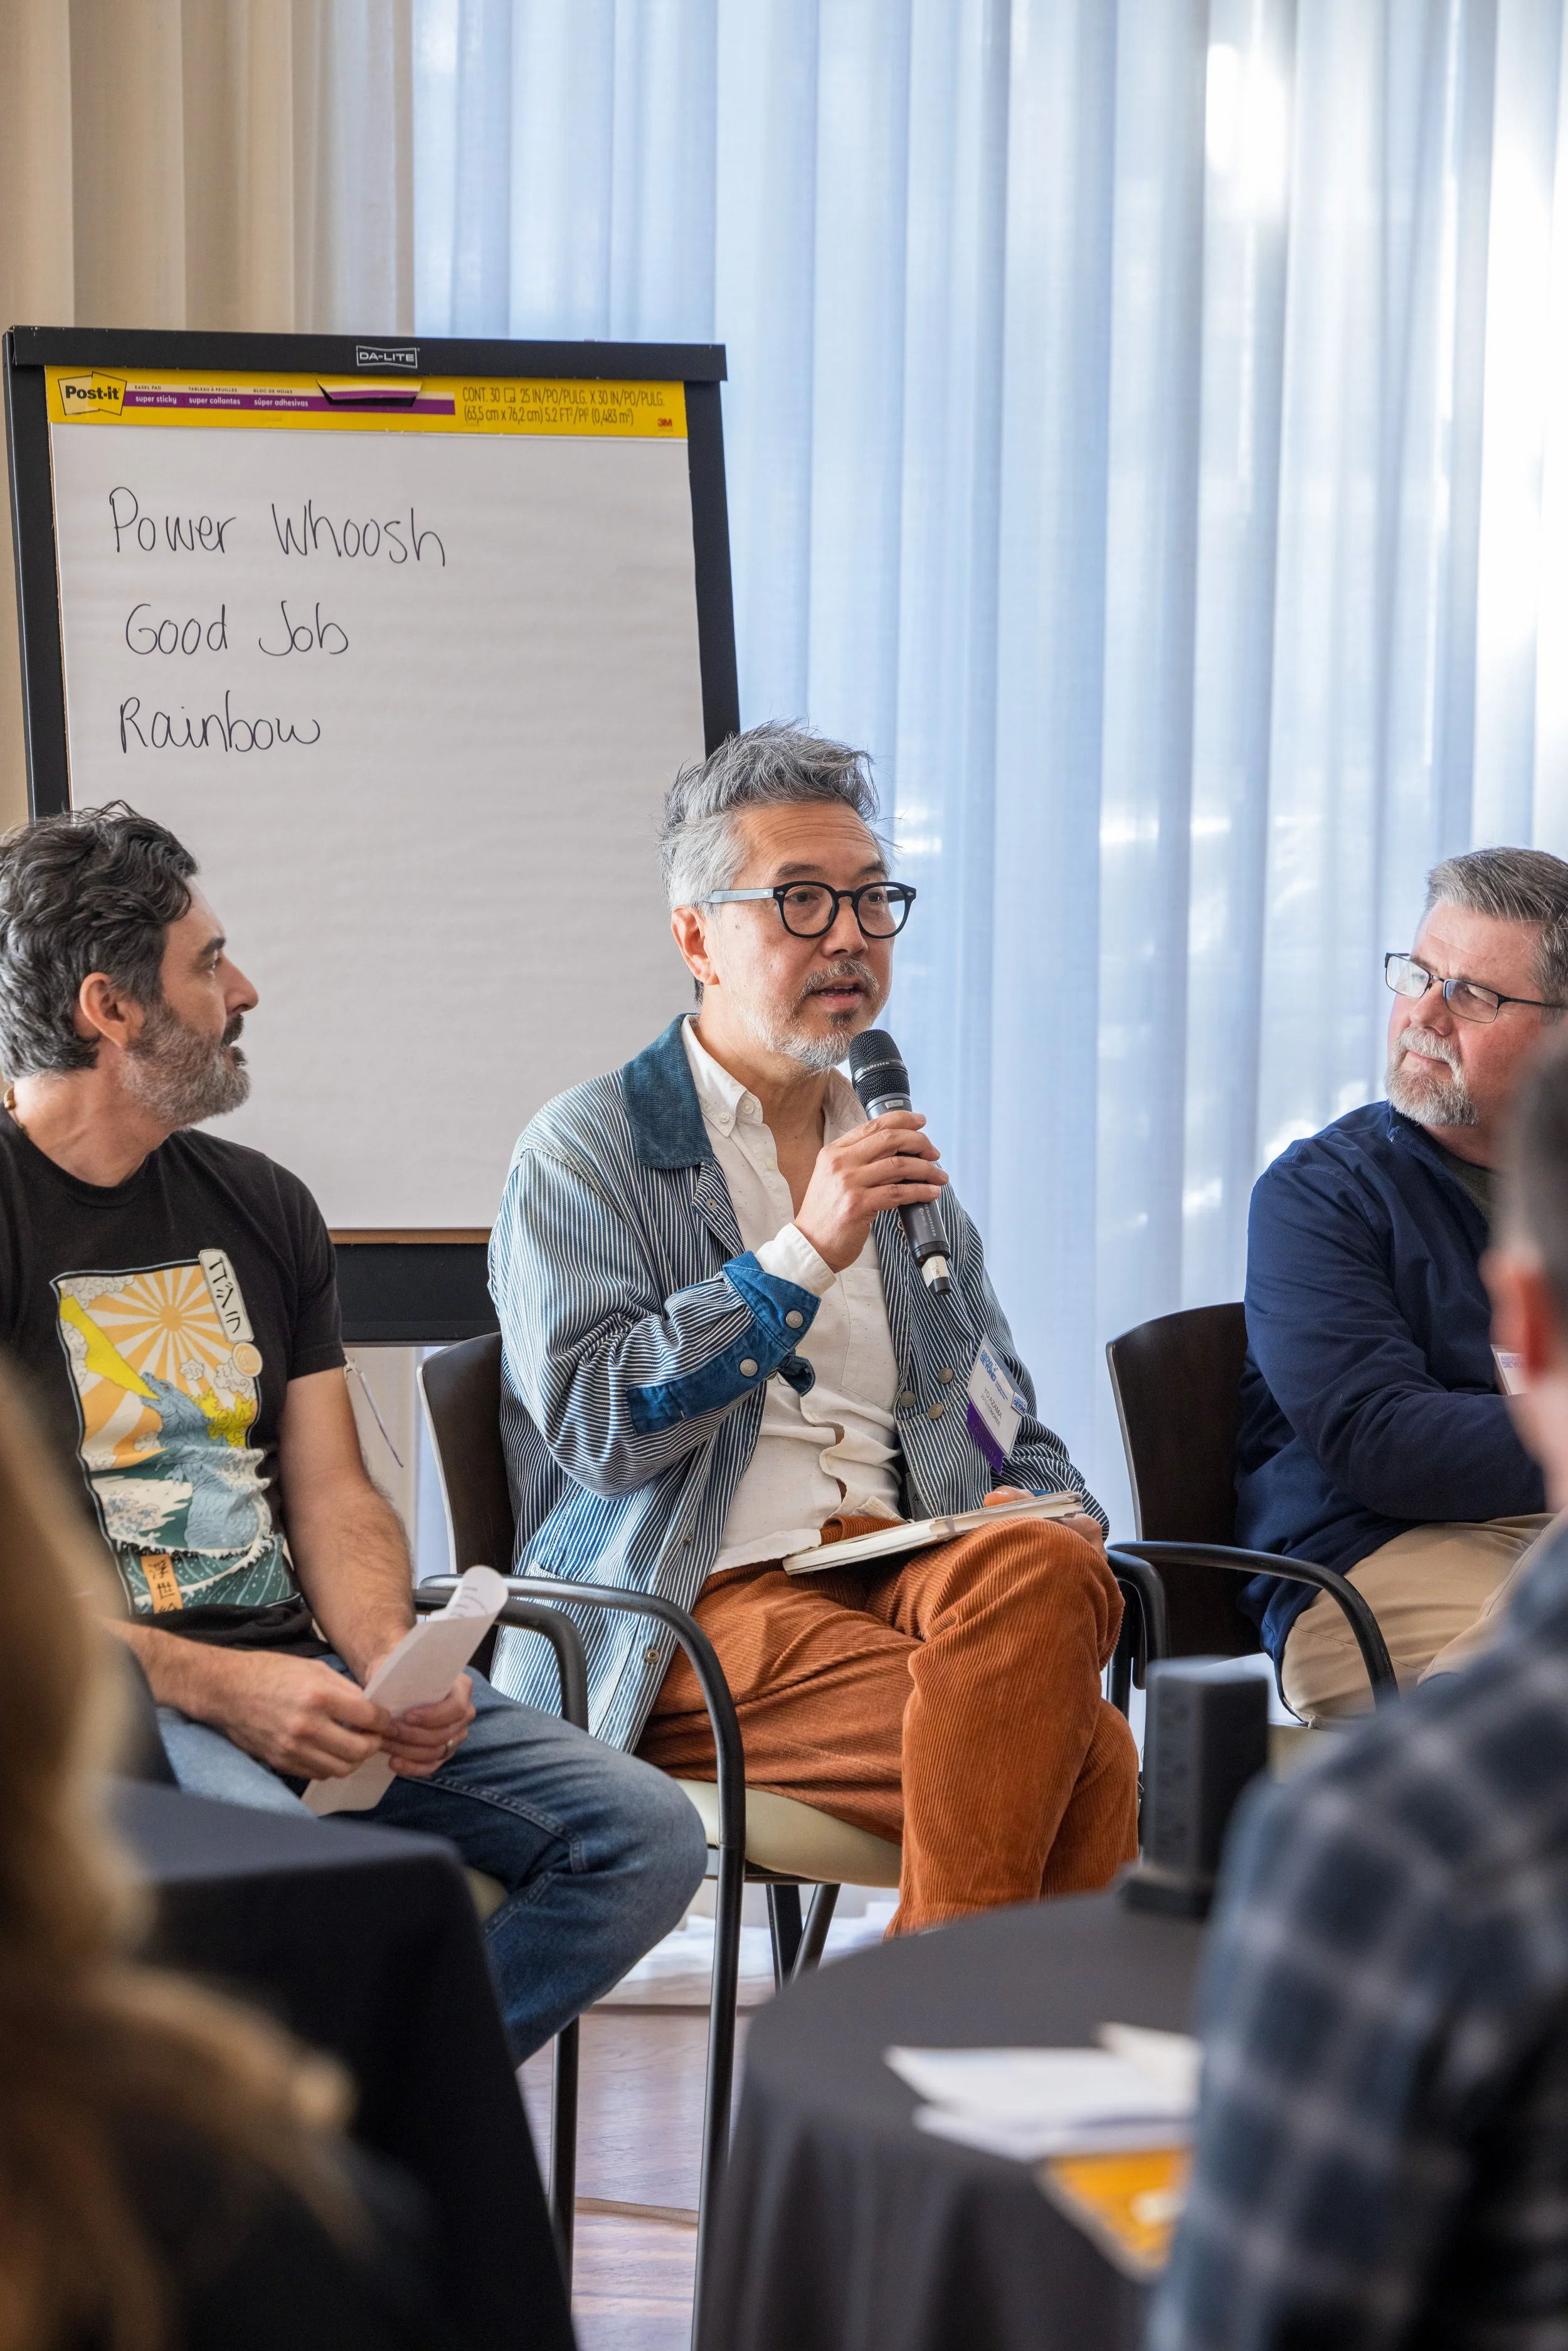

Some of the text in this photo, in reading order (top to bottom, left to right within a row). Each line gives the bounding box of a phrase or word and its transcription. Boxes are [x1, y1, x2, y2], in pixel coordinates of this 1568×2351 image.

[359, 352, 414, 363] DA-LITE
[65, 385, 119, 400] Post-it
[157, 395, 177, 405] sticky
[189, 396, 241, 405] super collantes
[463, 386, 488, 402] CONT.
[490, 387, 501, 403] 30
[520, 388, 530, 403] 25
[598, 390, 608, 405] 30
[254, 398, 309, 407] súper adhesivas
[464, 405, 484, 424] (63,5
[485, 409, 499, 421] cm
[501, 410, 507, 421] x
[508, 406, 525, 425] 76,2
[527, 406, 543, 425] cm)
[591, 407, 617, 427] (0,483
[657, 418, 672, 427] 3M
[109, 487, 445, 566] Power Whoosh
[125, 600, 349, 655] Good Job
[120, 690, 320, 753] Rainbow
[862, 1061, 889, 1072] NNHEISER
[209, 1257, 241, 1334] ゴジラ
[980, 1354, 996, 1382] BEYOND
